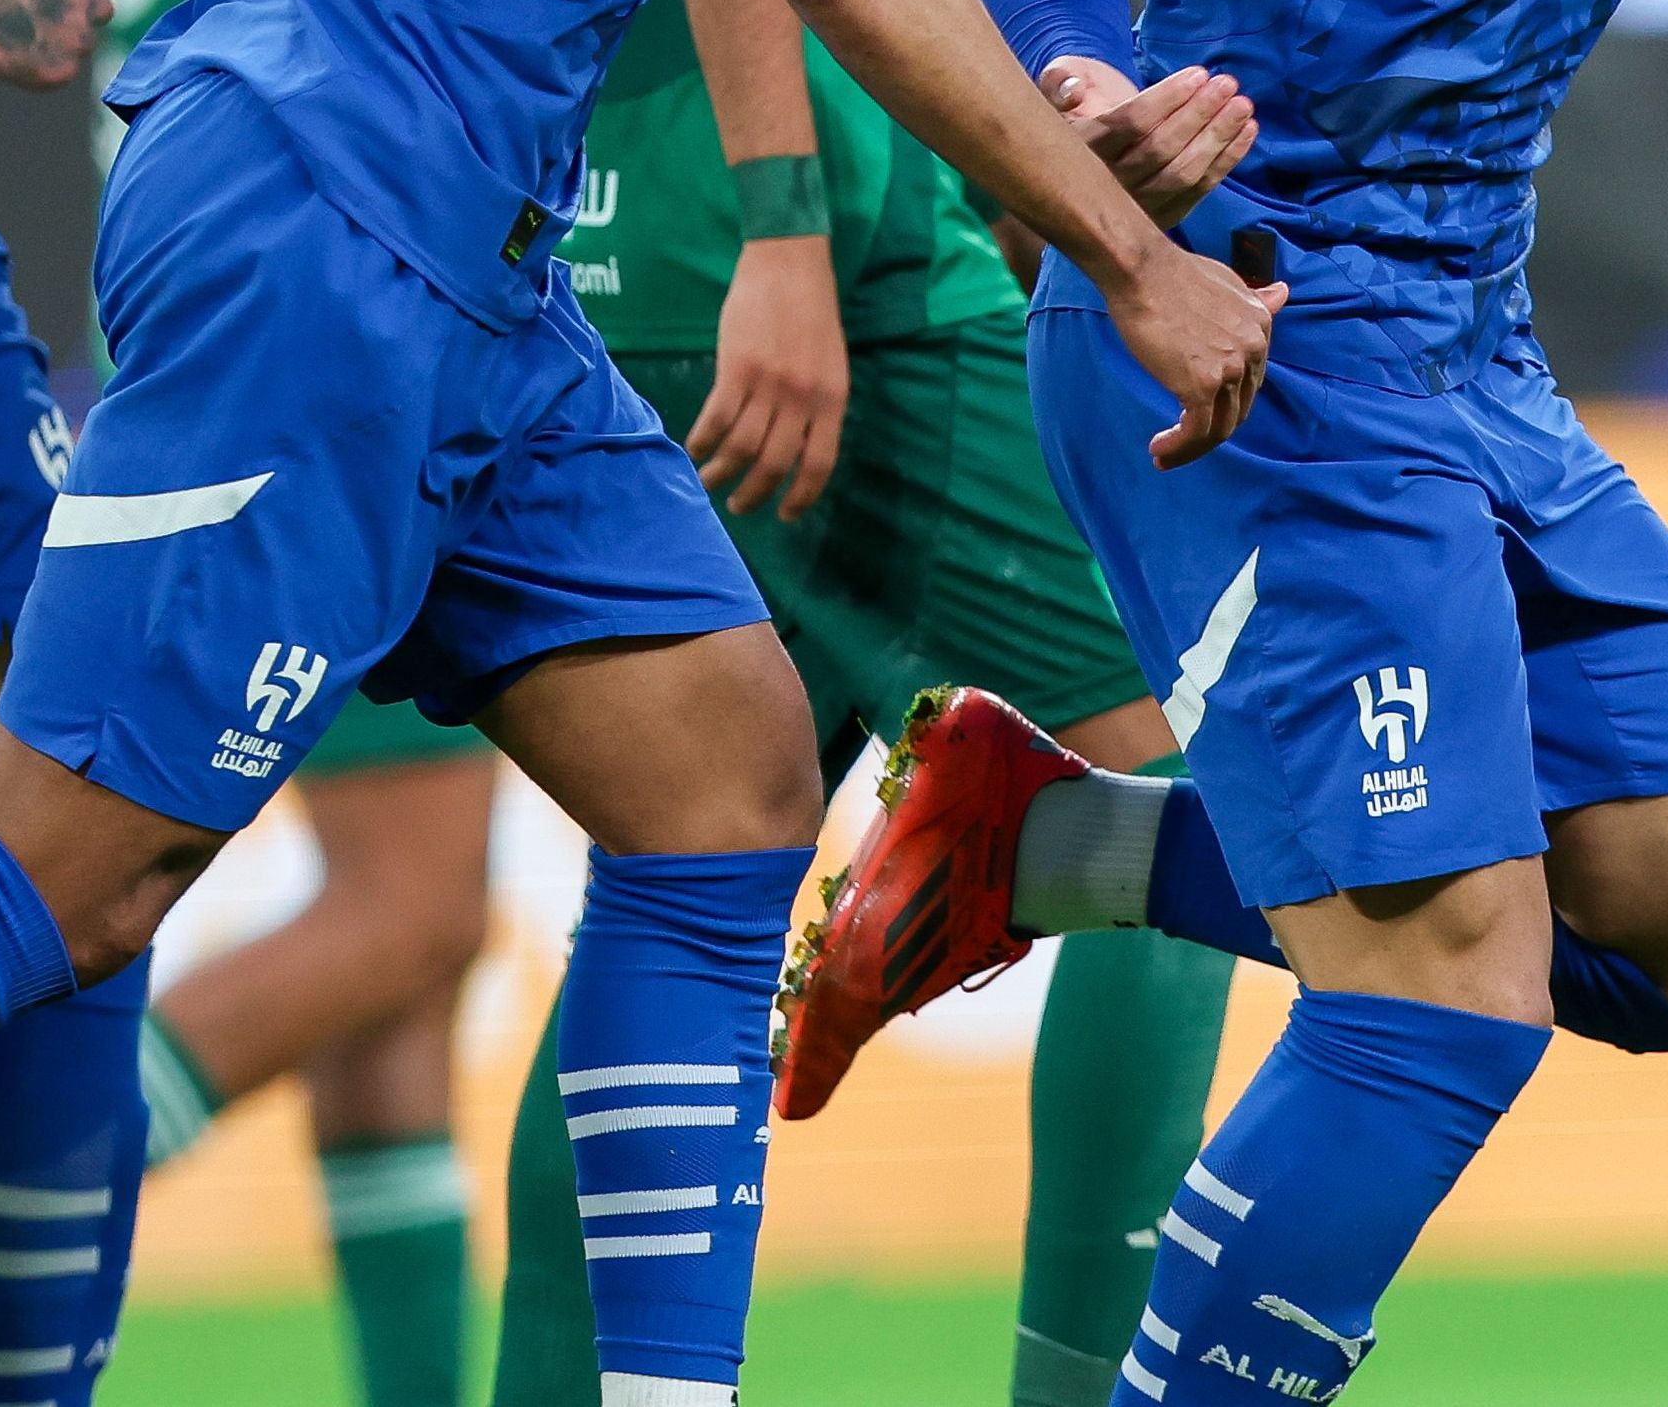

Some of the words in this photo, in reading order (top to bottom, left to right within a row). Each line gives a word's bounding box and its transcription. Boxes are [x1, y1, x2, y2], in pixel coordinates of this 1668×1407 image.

[216, 728, 284, 761] ALHILAL
[1362, 764, 1429, 794] ALHILAL
[1366, 786, 1428, 817] الهلال
[1198, 1344, 1257, 1382] AL
